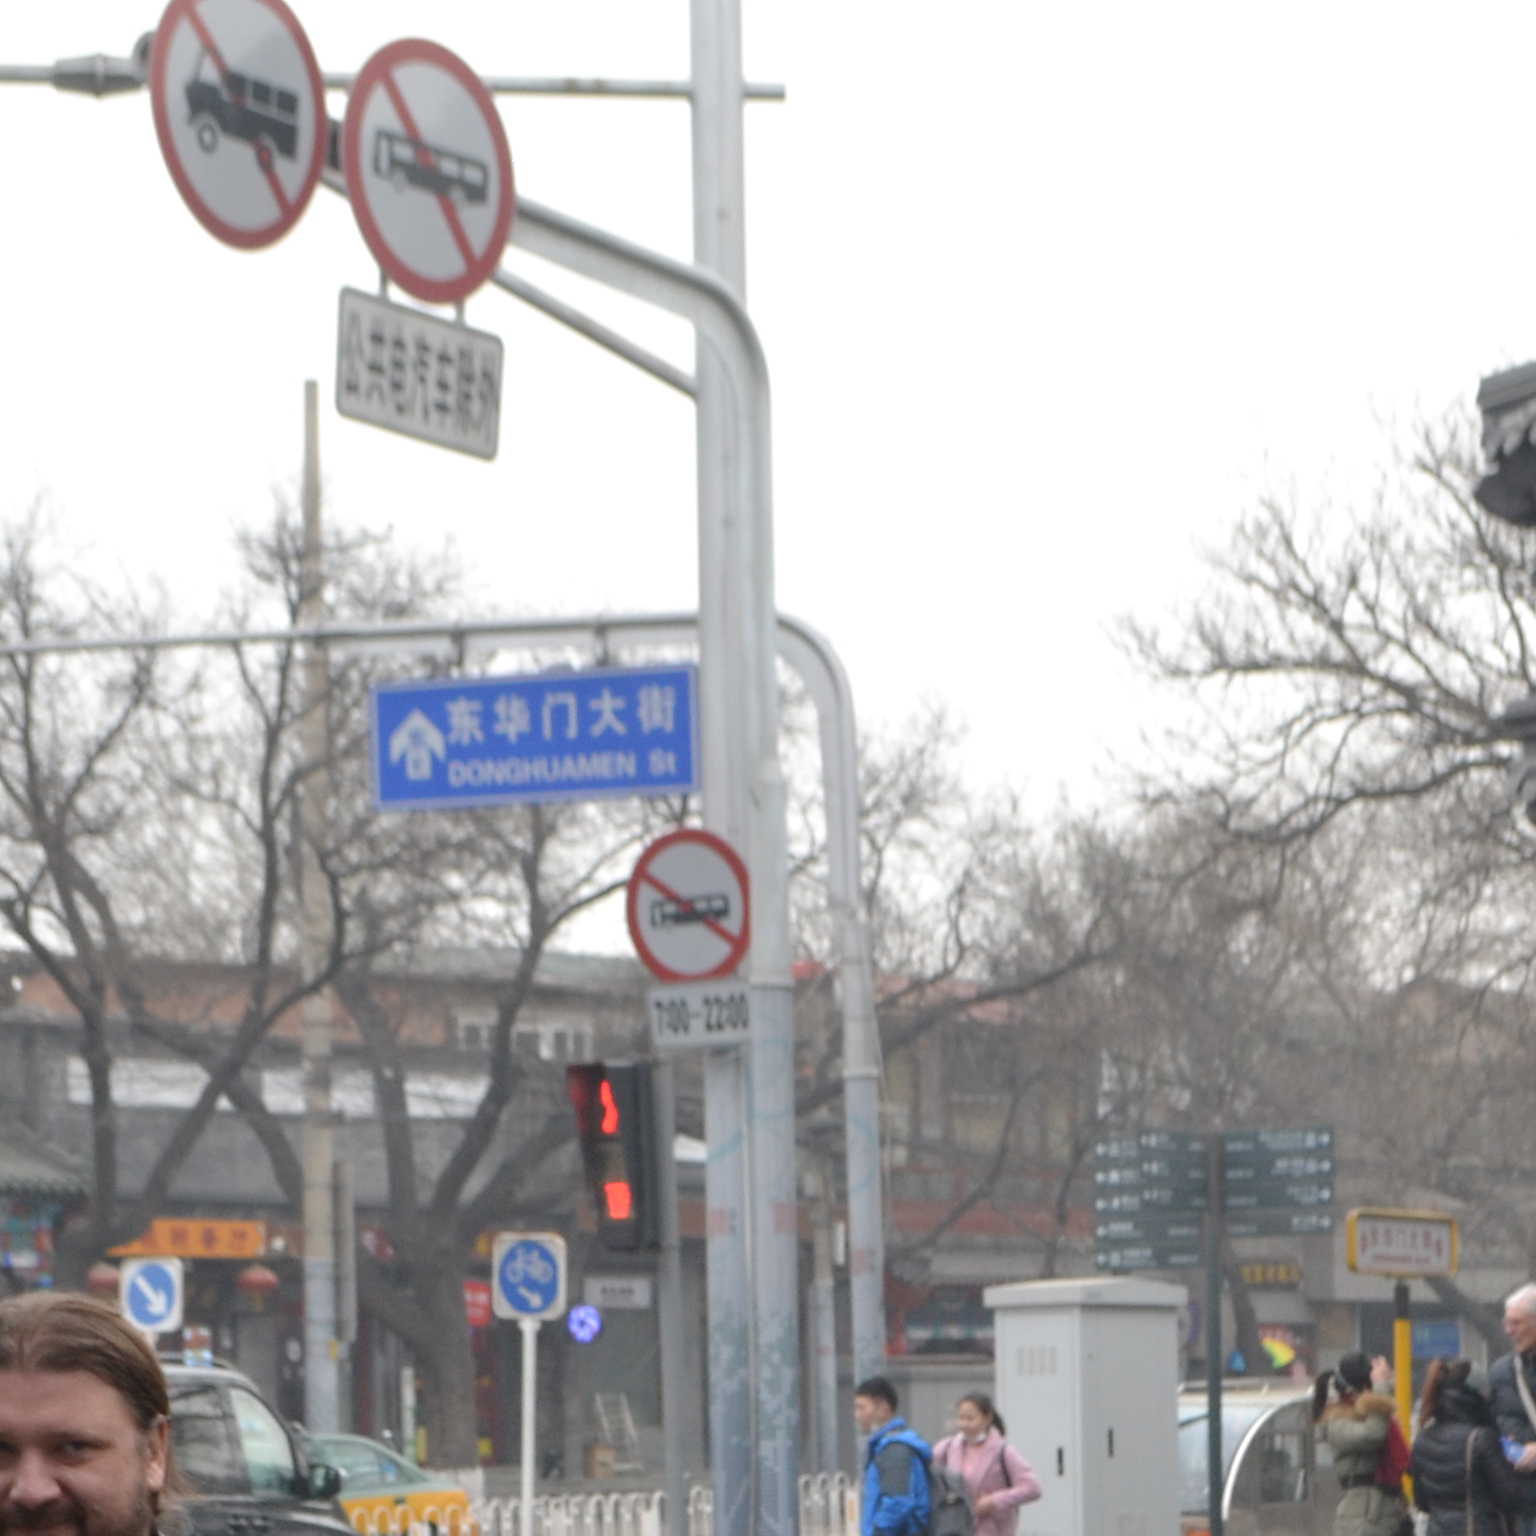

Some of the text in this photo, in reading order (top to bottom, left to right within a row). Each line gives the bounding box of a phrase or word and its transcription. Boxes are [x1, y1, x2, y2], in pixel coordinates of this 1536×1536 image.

[445, 685, 676, 747] 东华门大街
[447, 751, 637, 788] DONGHUAMEN
